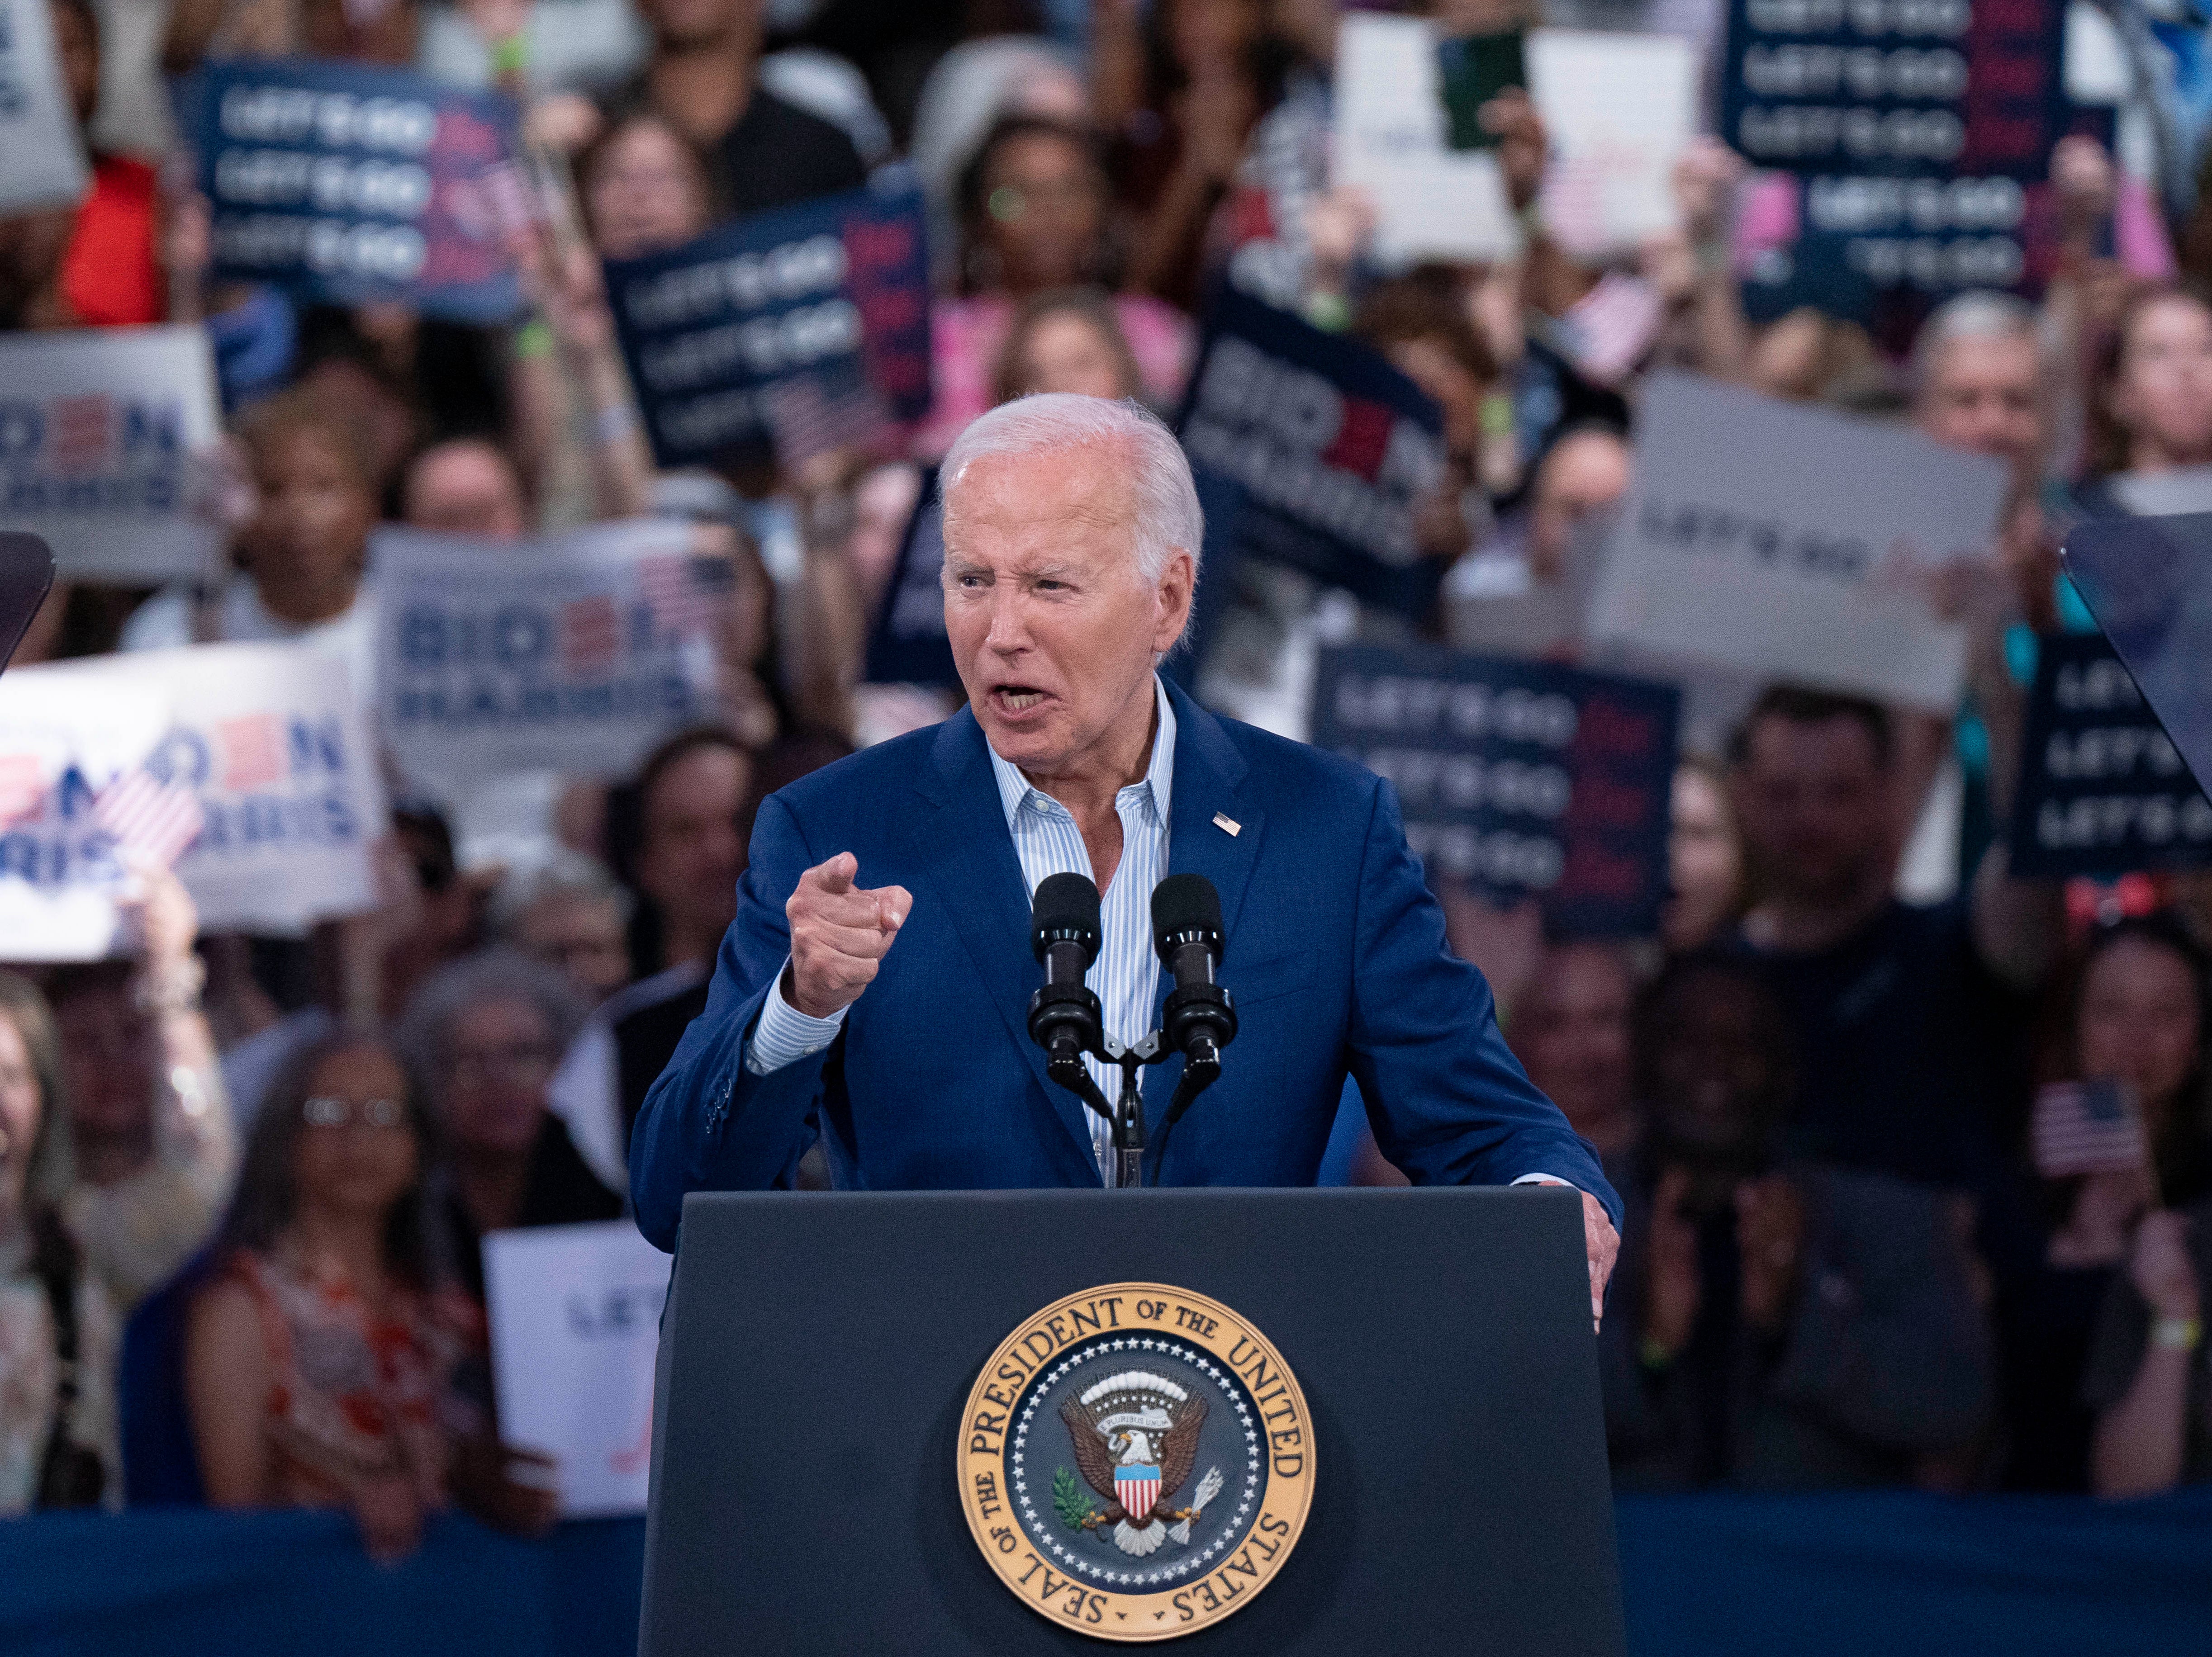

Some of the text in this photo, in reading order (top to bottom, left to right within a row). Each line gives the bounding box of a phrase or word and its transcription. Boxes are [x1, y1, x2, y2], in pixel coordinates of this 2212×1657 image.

[1740, 42, 1883, 96] LET'S
[1885, 47, 1967, 100] GO
[1737, 104, 1880, 157] LET'S
[1882, 108, 1964, 161] GO
[1809, 175, 1944, 232] LET'S
[1945, 176, 2024, 231] GO
[1333, 673, 1493, 738] LET'S
[1494, 686, 1578, 750] GO
[971, 1297, 1302, 1624] SEAL OF THE PRESIDENT OF THE UNITED STATES
